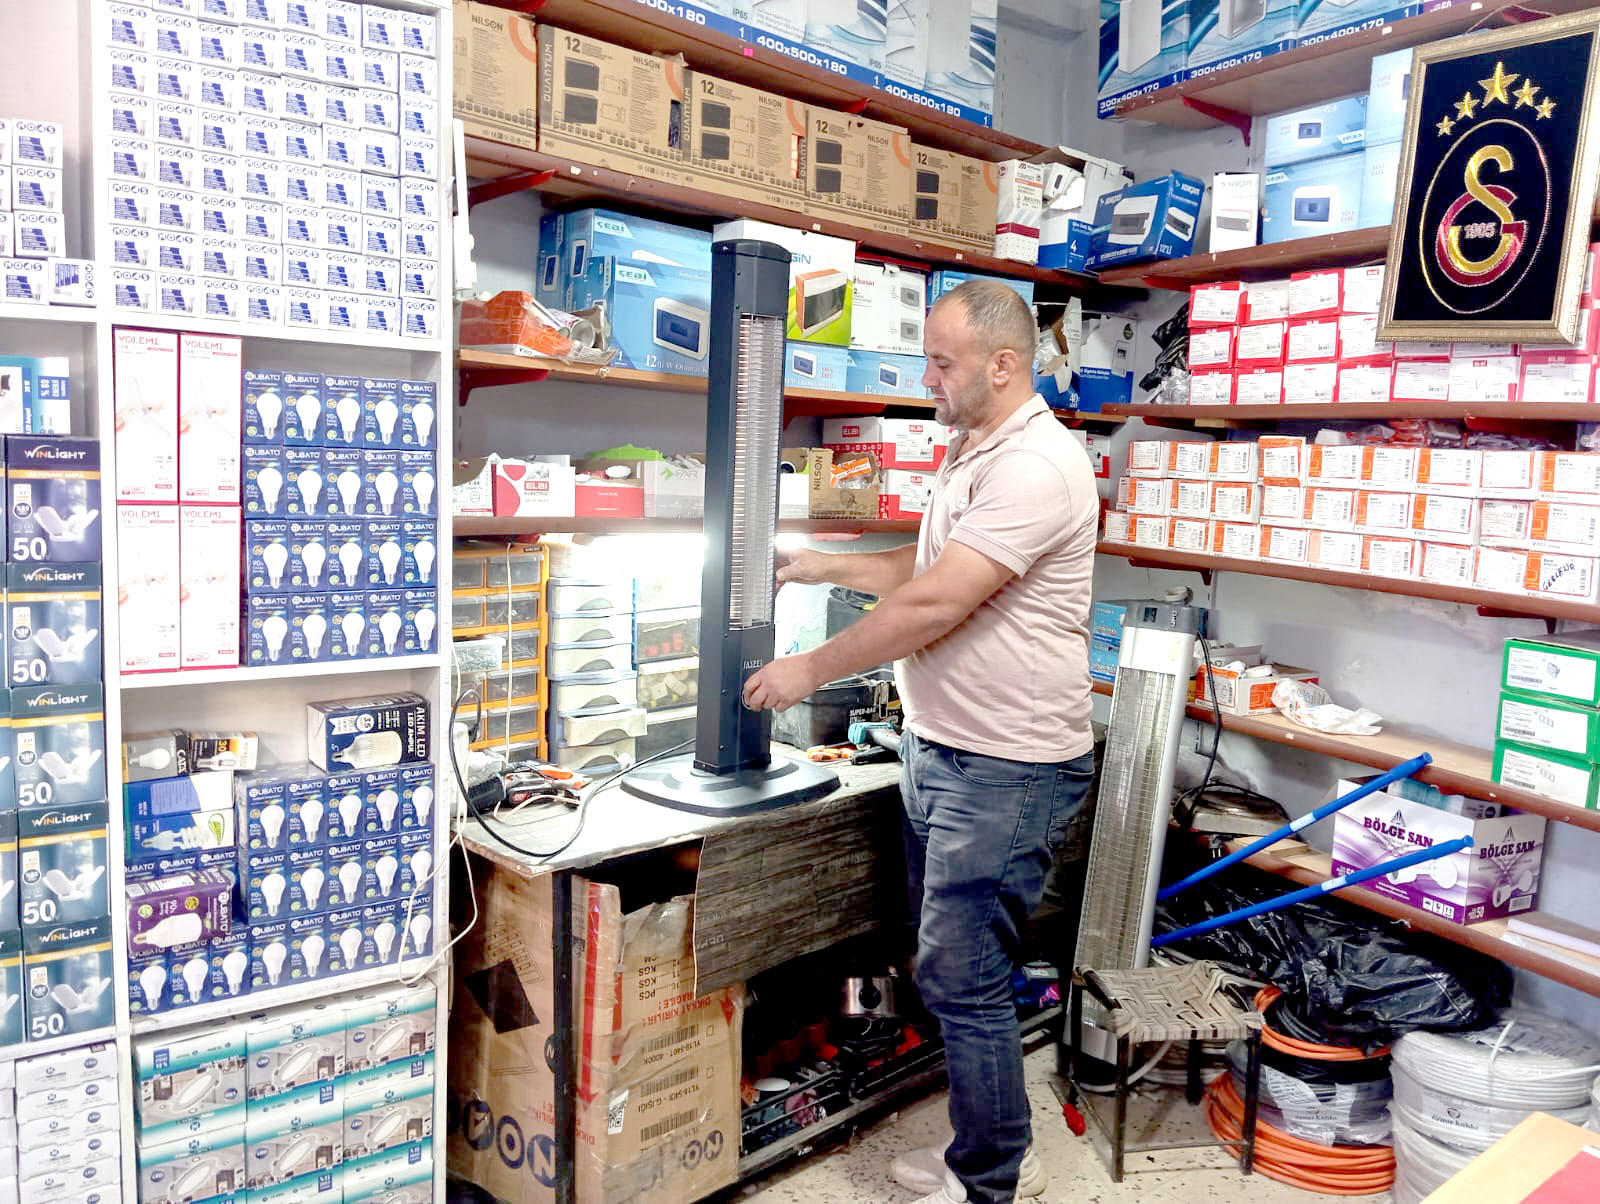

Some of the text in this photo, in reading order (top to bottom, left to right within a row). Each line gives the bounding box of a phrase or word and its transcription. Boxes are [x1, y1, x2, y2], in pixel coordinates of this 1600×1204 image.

[472, 14, 504, 31] NILSON
[1301, 18, 1384, 48] 300x400x170
[565, 36, 580, 53] 12
[632, 55, 661, 69] NILSON
[757, 36, 847, 75] 400x500x180
[543, 44, 552, 102] QUANTUM
[1191, 51, 1262, 79] 300x400x170
[701, 80, 714, 95] 12
[759, 95, 782, 108] NILSON
[885, 85, 960, 117] 400x500x180
[816, 120, 828, 134] 12
[917, 152, 927, 165] 12
[24, 445, 86, 459] WINLIGHT
[814, 456, 823, 490] NILSON
[524, 481, 549, 491] ELBI
[23, 566, 84, 582] WINLIGHT
[27, 691, 89, 706] WINLIGHT
[416, 706, 425, 757] AKIM LED
[177, 750, 186, 773] CATA
[32, 810, 92, 826] WINLIGHT
[1364, 817, 1434, 847] BÖLGE SAN
[1480, 840, 1535, 860] BÖLGE SAN
[39, 925, 98, 943] WINLIGHT
[639, 966, 657, 976] KGS
[639, 978, 657, 988] KGS
[639, 991, 656, 1000] PCS
